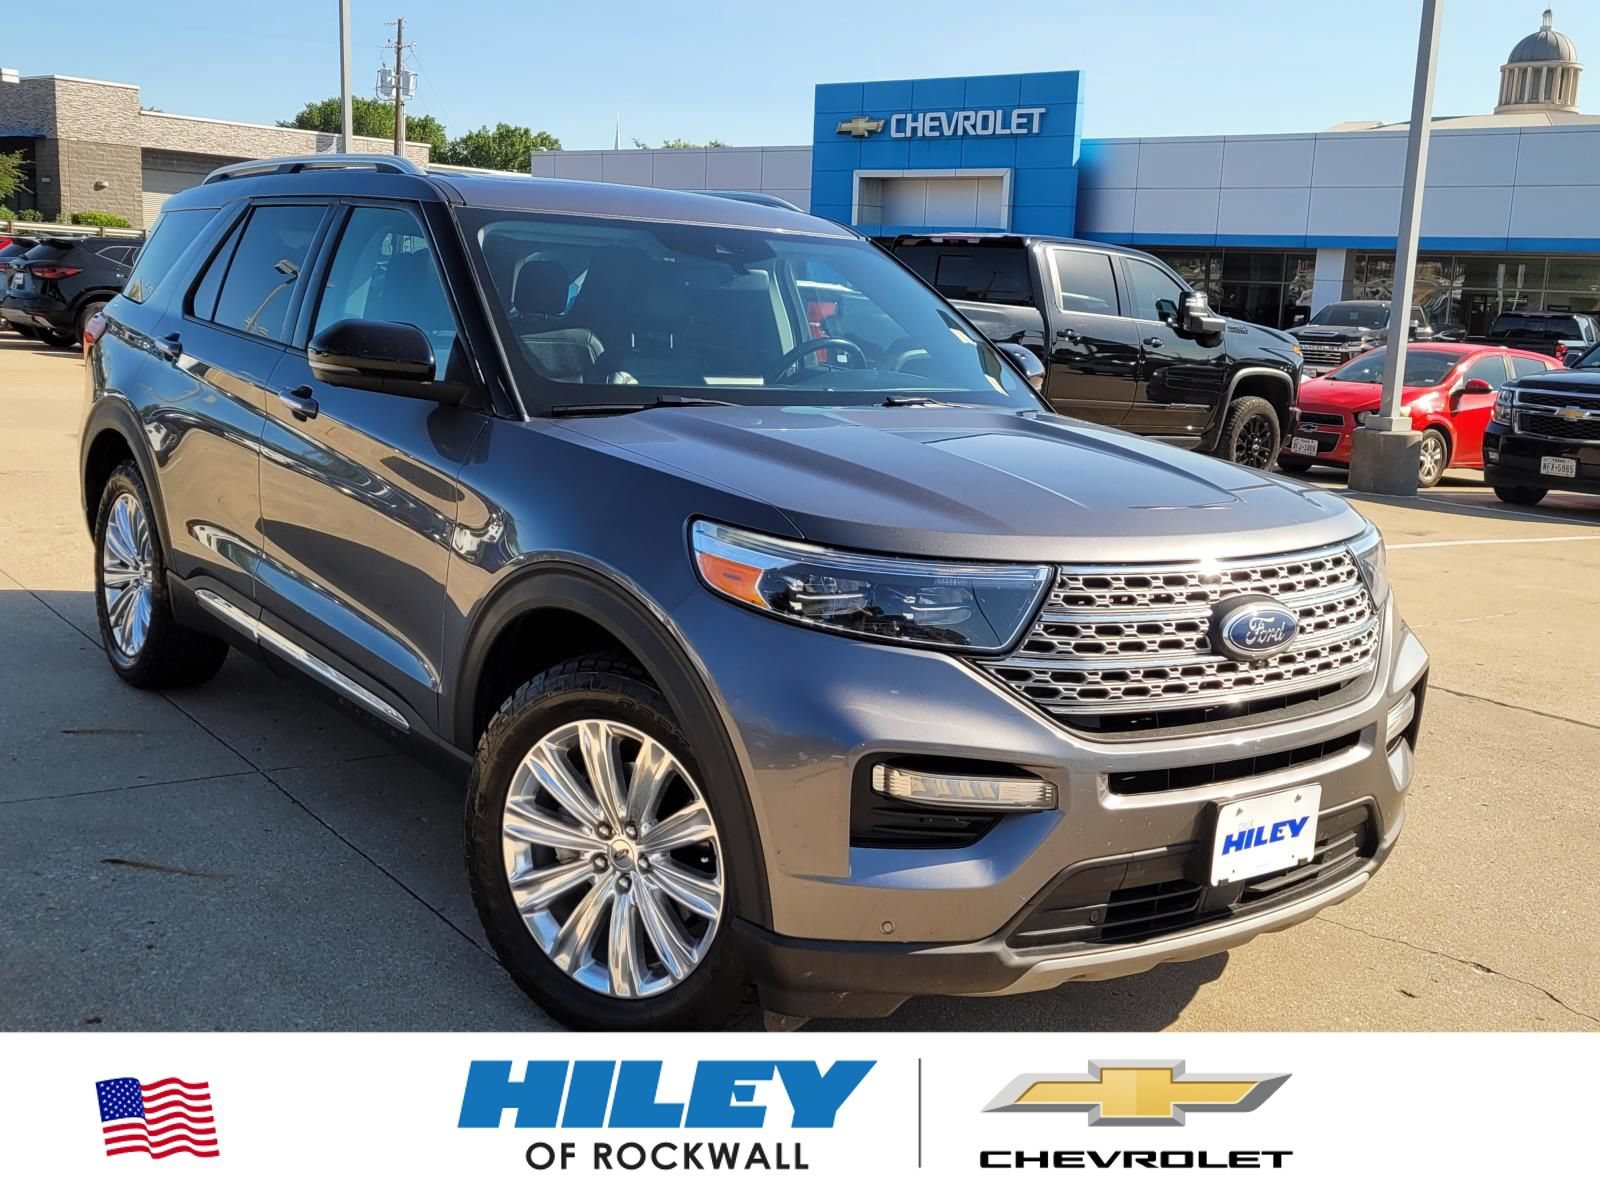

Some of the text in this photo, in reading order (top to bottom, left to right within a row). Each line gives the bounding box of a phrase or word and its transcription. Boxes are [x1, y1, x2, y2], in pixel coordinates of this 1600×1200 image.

[890, 108, 1046, 138] CHEVROLET
[1246, 617, 1286, 645] Ford
[1222, 816, 1310, 856] HILEY
